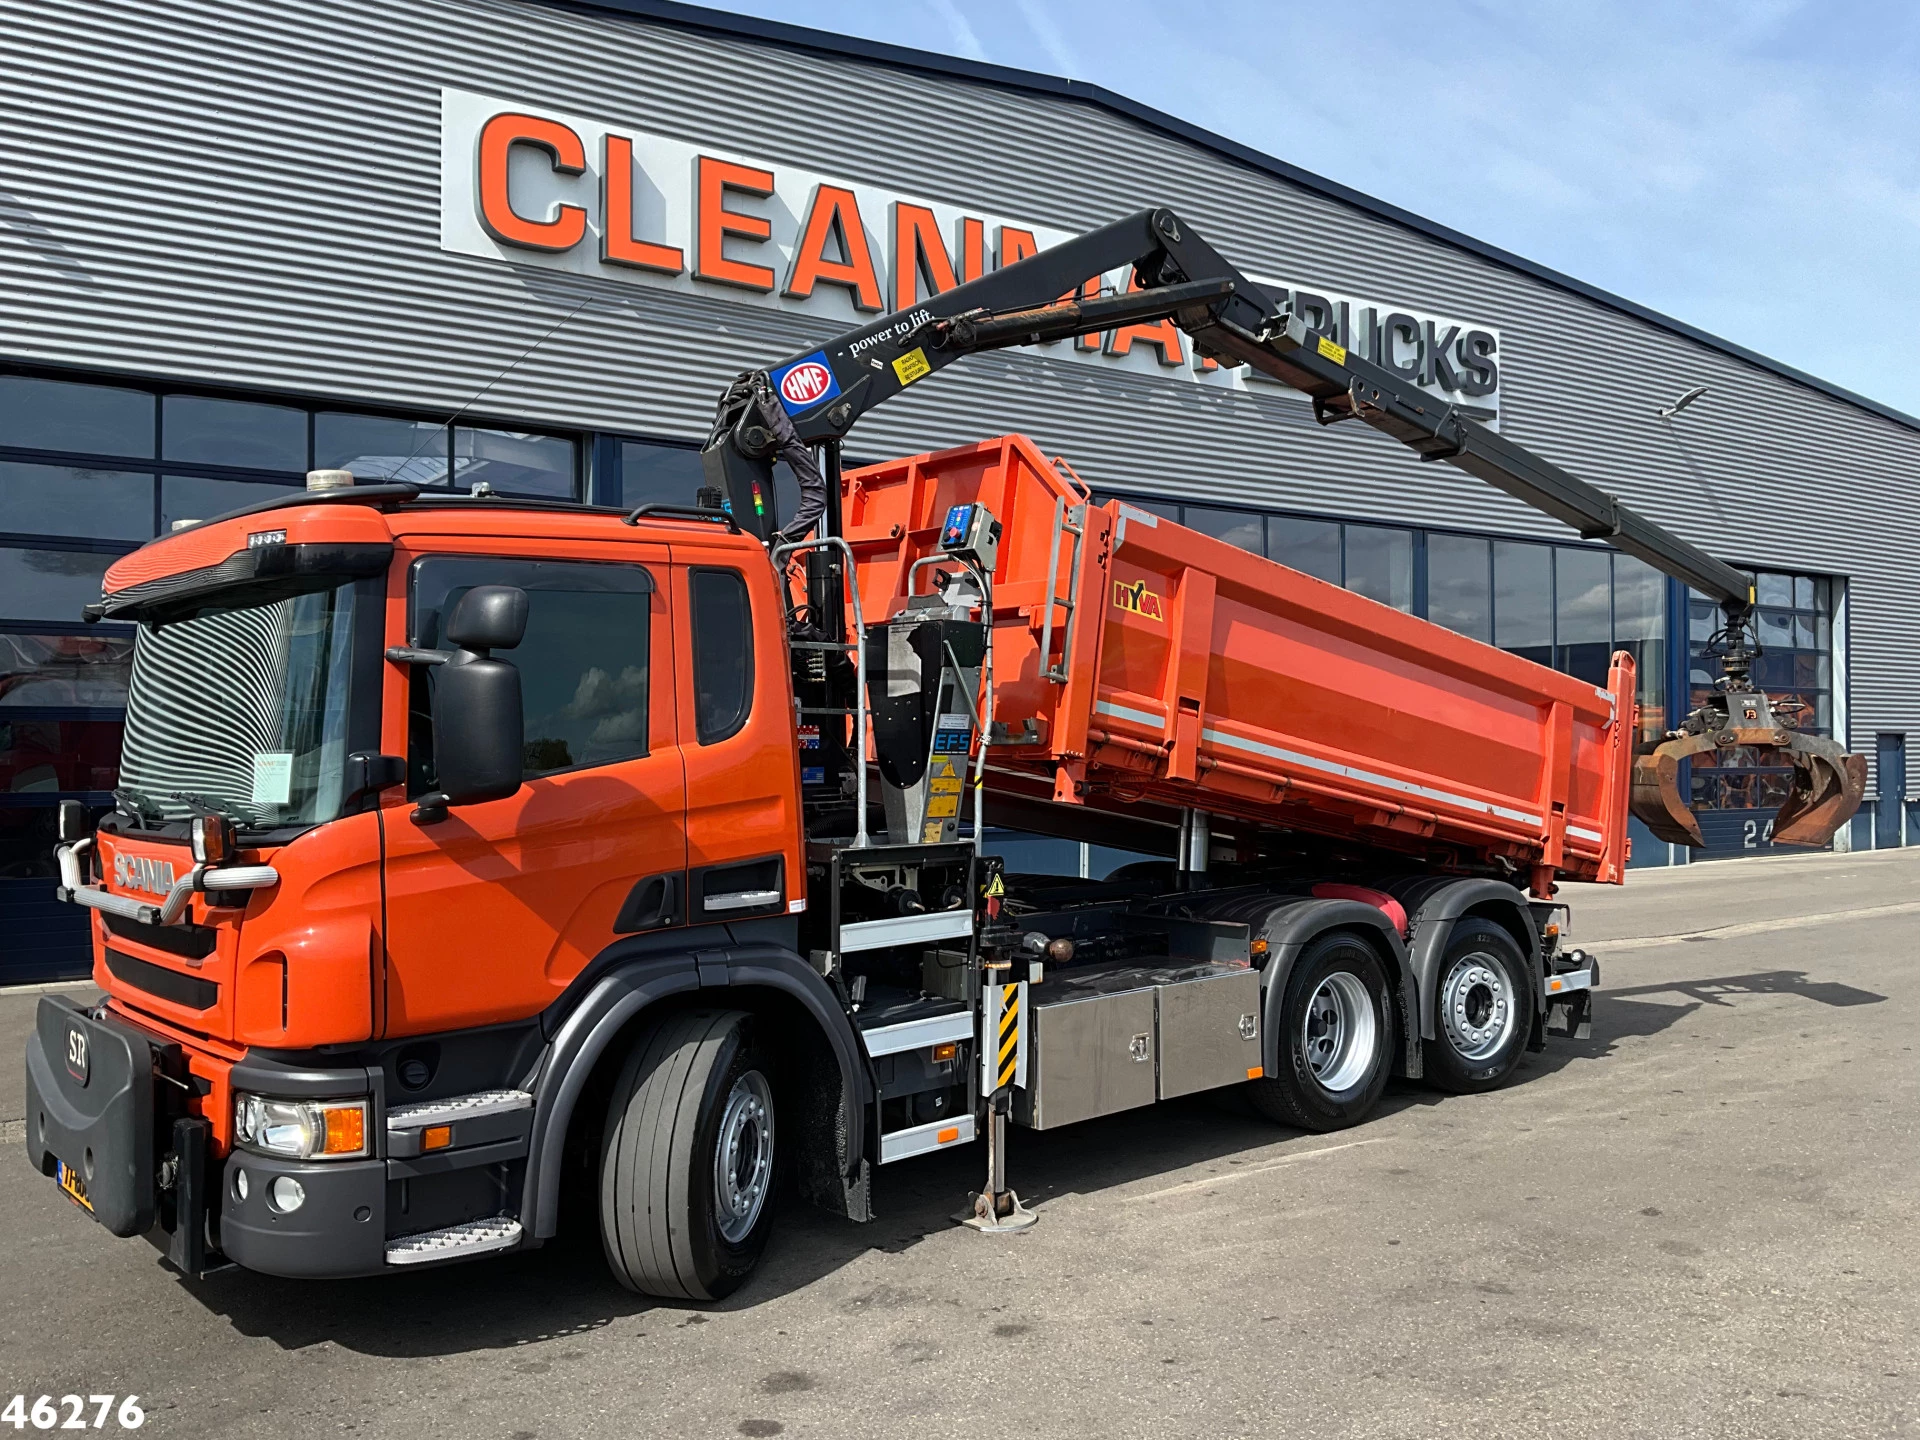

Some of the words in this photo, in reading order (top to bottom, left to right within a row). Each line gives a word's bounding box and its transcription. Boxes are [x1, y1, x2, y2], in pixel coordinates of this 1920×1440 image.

[849, 329, 892, 358] power
[894, 322, 910, 335] to
[1250, 280, 1498, 397] RUCKS
[786, 367, 823, 400] HMF
[1116, 583, 1161, 619] HYVA
[935, 733, 970, 750] EFS
[114, 852, 175, 896] SCANIA
[69, 1029, 85, 1068] SR
